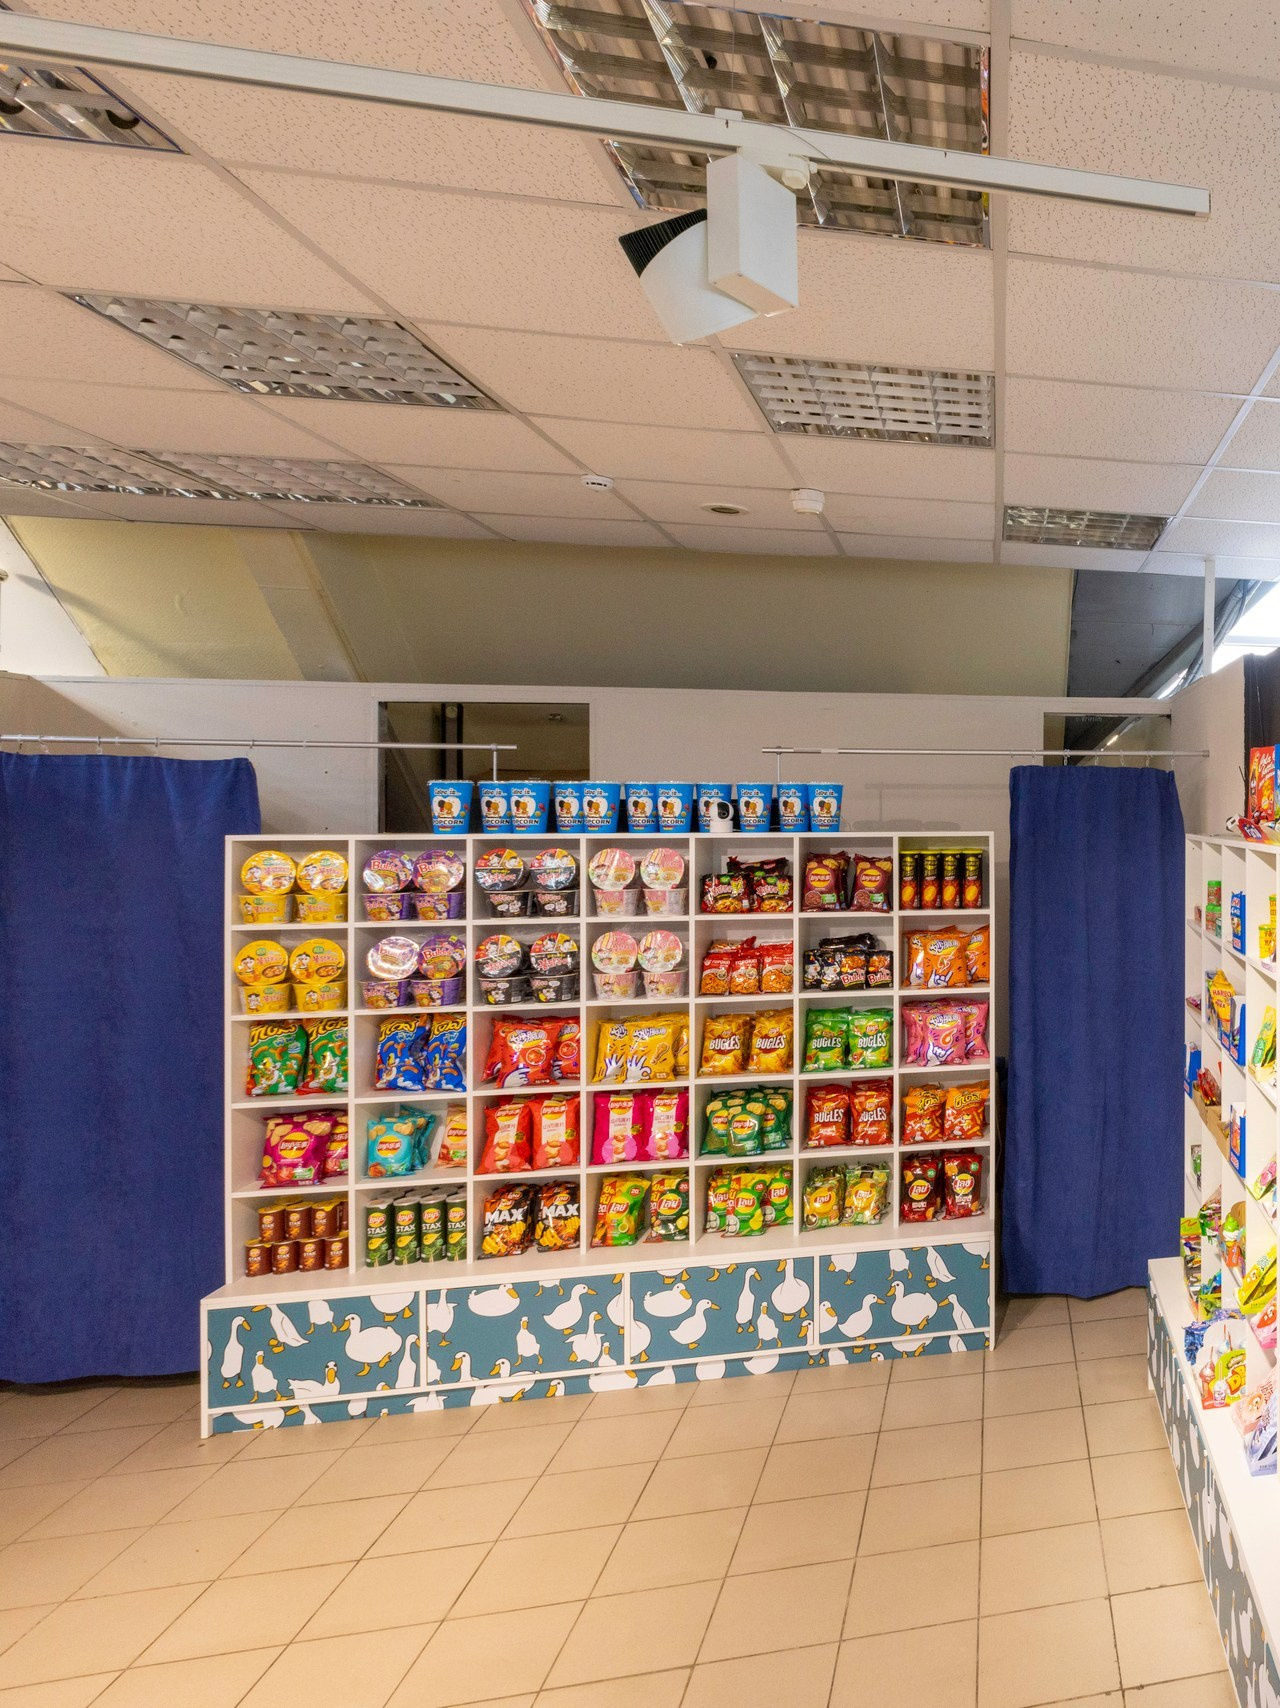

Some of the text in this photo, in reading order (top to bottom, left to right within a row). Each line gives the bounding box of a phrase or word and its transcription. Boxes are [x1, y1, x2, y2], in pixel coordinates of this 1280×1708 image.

[709, 1036, 740, 1050] BUGLES
[755, 1035, 786, 1049] BUGLES
[812, 1037, 841, 1048] BUGLES
[857, 1032, 886, 1047] BUGLES
[814, 1109, 844, 1123] BUGLES
[859, 1109, 887, 1122] BUGLES
[485, 1208, 525, 1224] MAX
[541, 1203, 579, 1217] MAX
[368, 1226, 387, 1234] STAX
[396, 1224, 416, 1233] STAX
[422, 1222, 442, 1230] STAX
[447, 1221, 466, 1229] STAX
